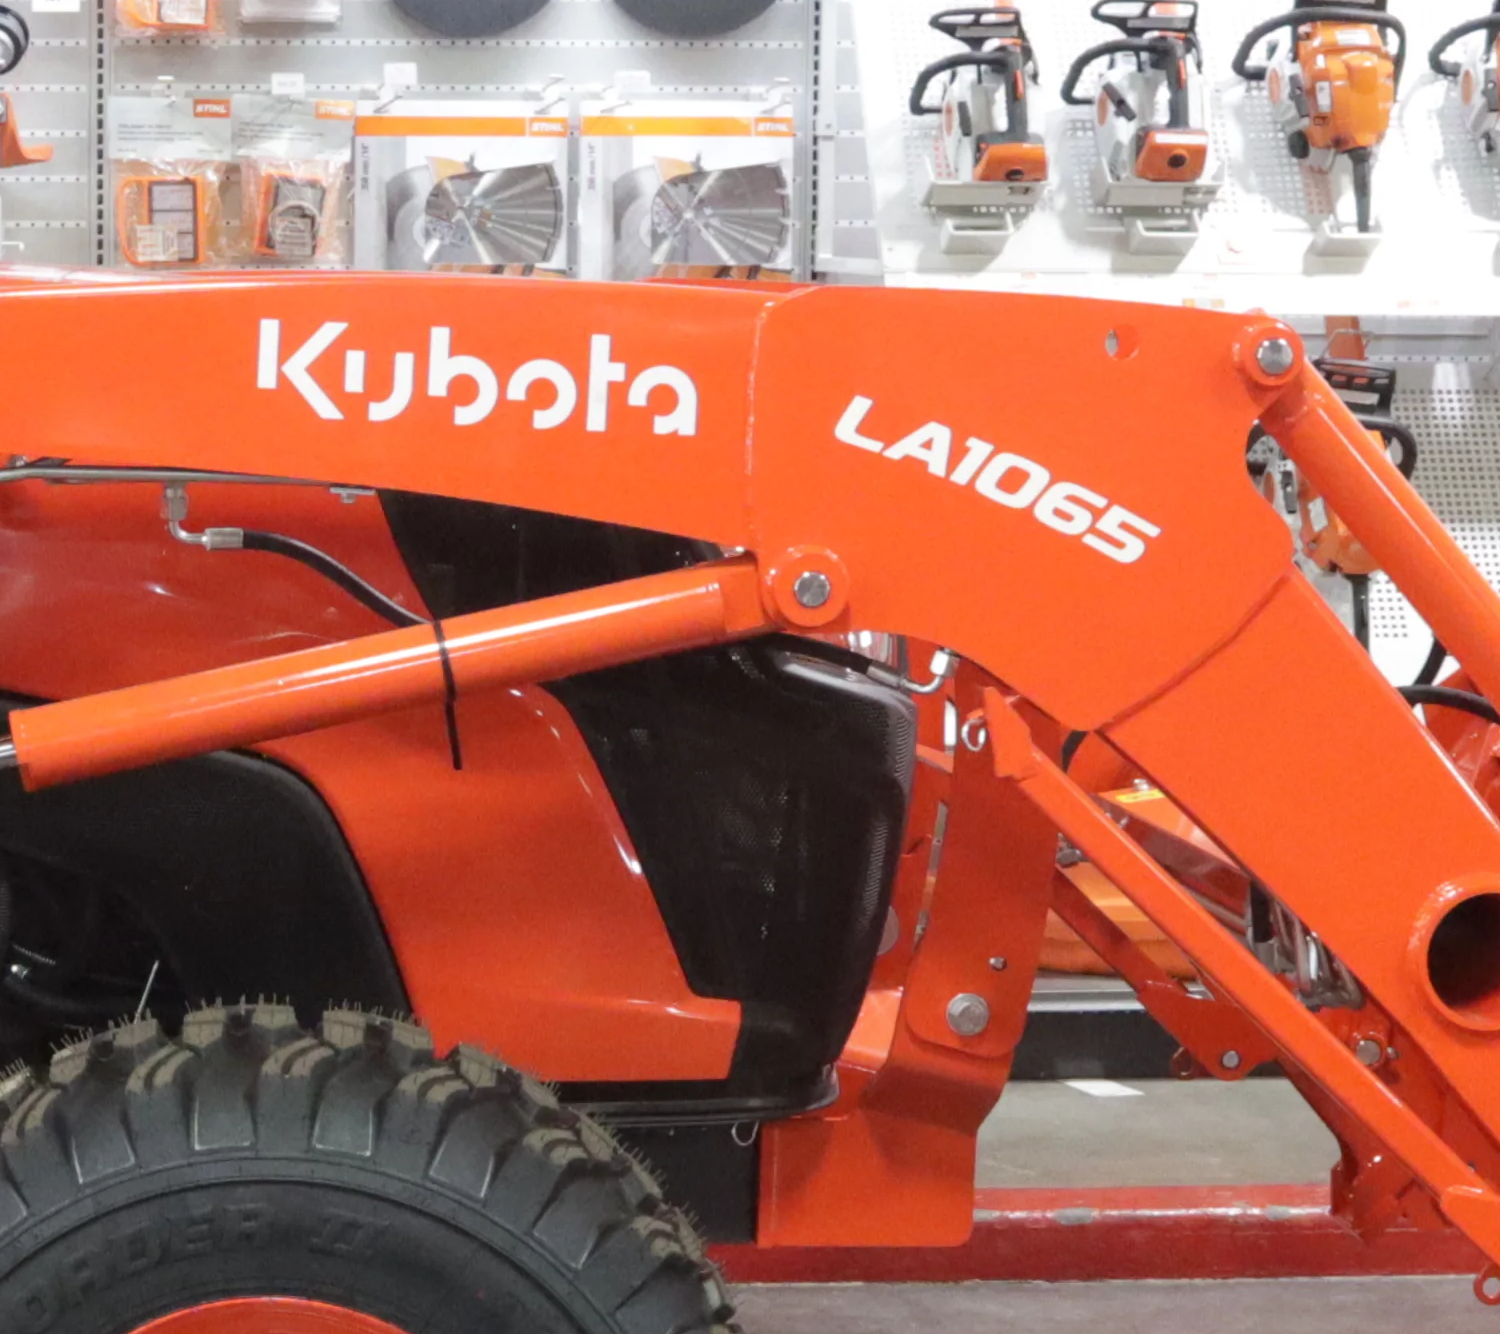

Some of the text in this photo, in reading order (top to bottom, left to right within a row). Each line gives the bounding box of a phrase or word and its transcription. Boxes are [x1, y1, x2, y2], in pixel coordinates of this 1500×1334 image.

[195, 103, 228, 114] STIHL
[318, 102, 352, 115] STIHL
[531, 122, 565, 133] STIHL
[757, 122, 790, 133] STIHL
[257, 319, 696, 436] Kubota
[834, 396, 1160, 563] LA1065
